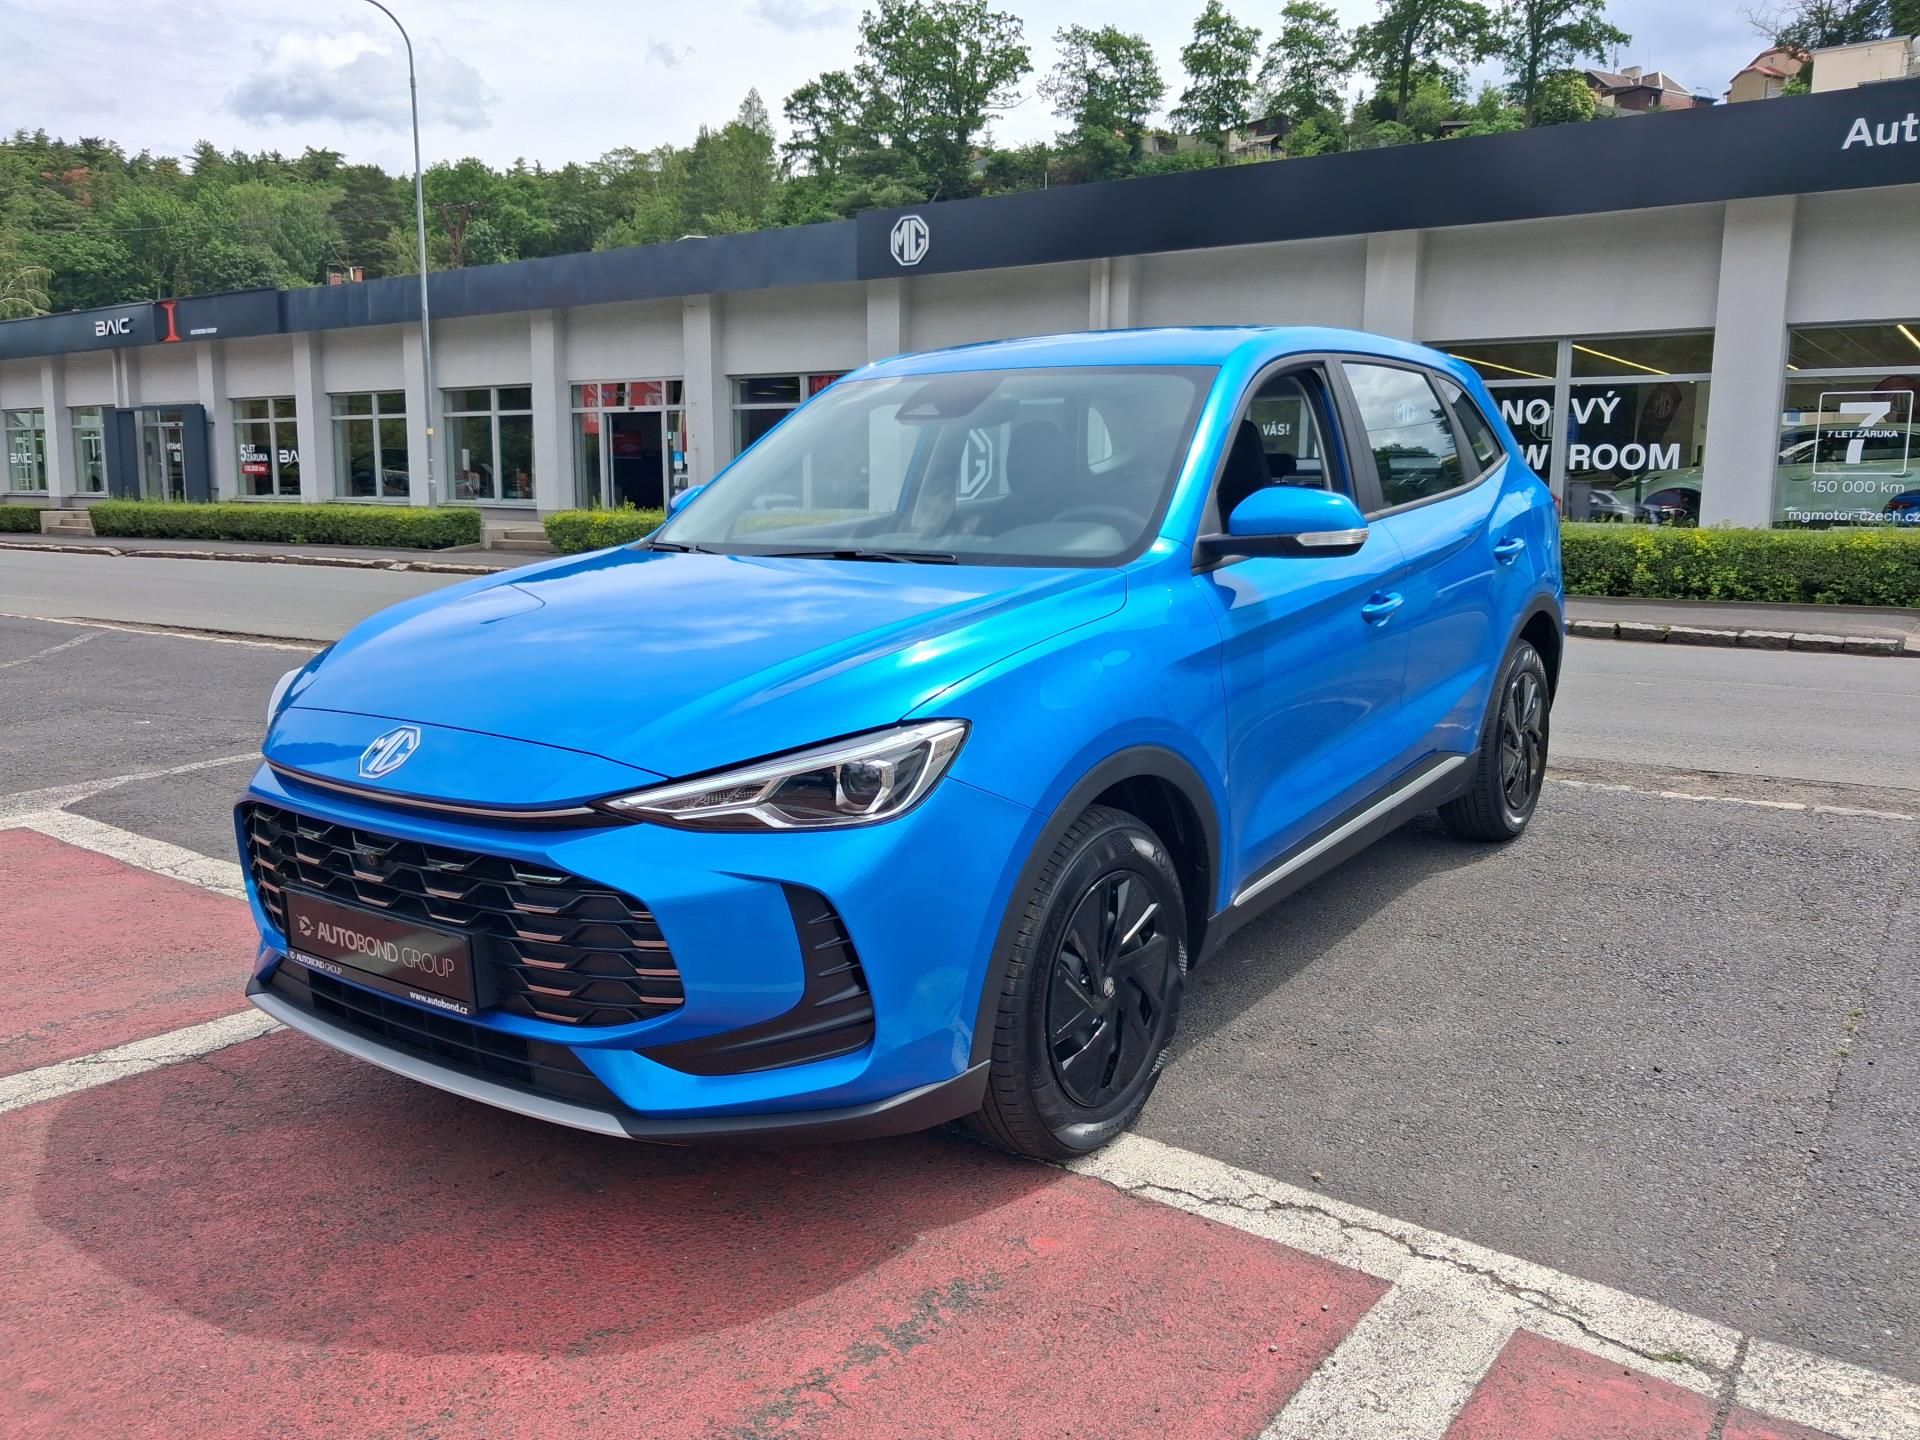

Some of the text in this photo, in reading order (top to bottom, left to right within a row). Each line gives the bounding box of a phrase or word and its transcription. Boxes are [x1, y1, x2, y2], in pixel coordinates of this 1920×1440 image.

[1841, 113, 1920, 150] Aut
[892, 216, 928, 265] MG
[95, 318, 130, 336] BAIC
[1262, 421, 1290, 436] VÁS!
[1827, 429, 1898, 438] 7 LET ZÁRUKA
[1840, 402, 1891, 464] 7
[279, 450, 299, 463] BA
[1810, 481, 1905, 493] 150 000 km
[361, 727, 419, 777] MG
[317, 921, 454, 978] AUTOBOND GROUP
[297, 953, 342, 975] AUTOBOND GROUP
[409, 991, 468, 1014] www.autobond.cz
